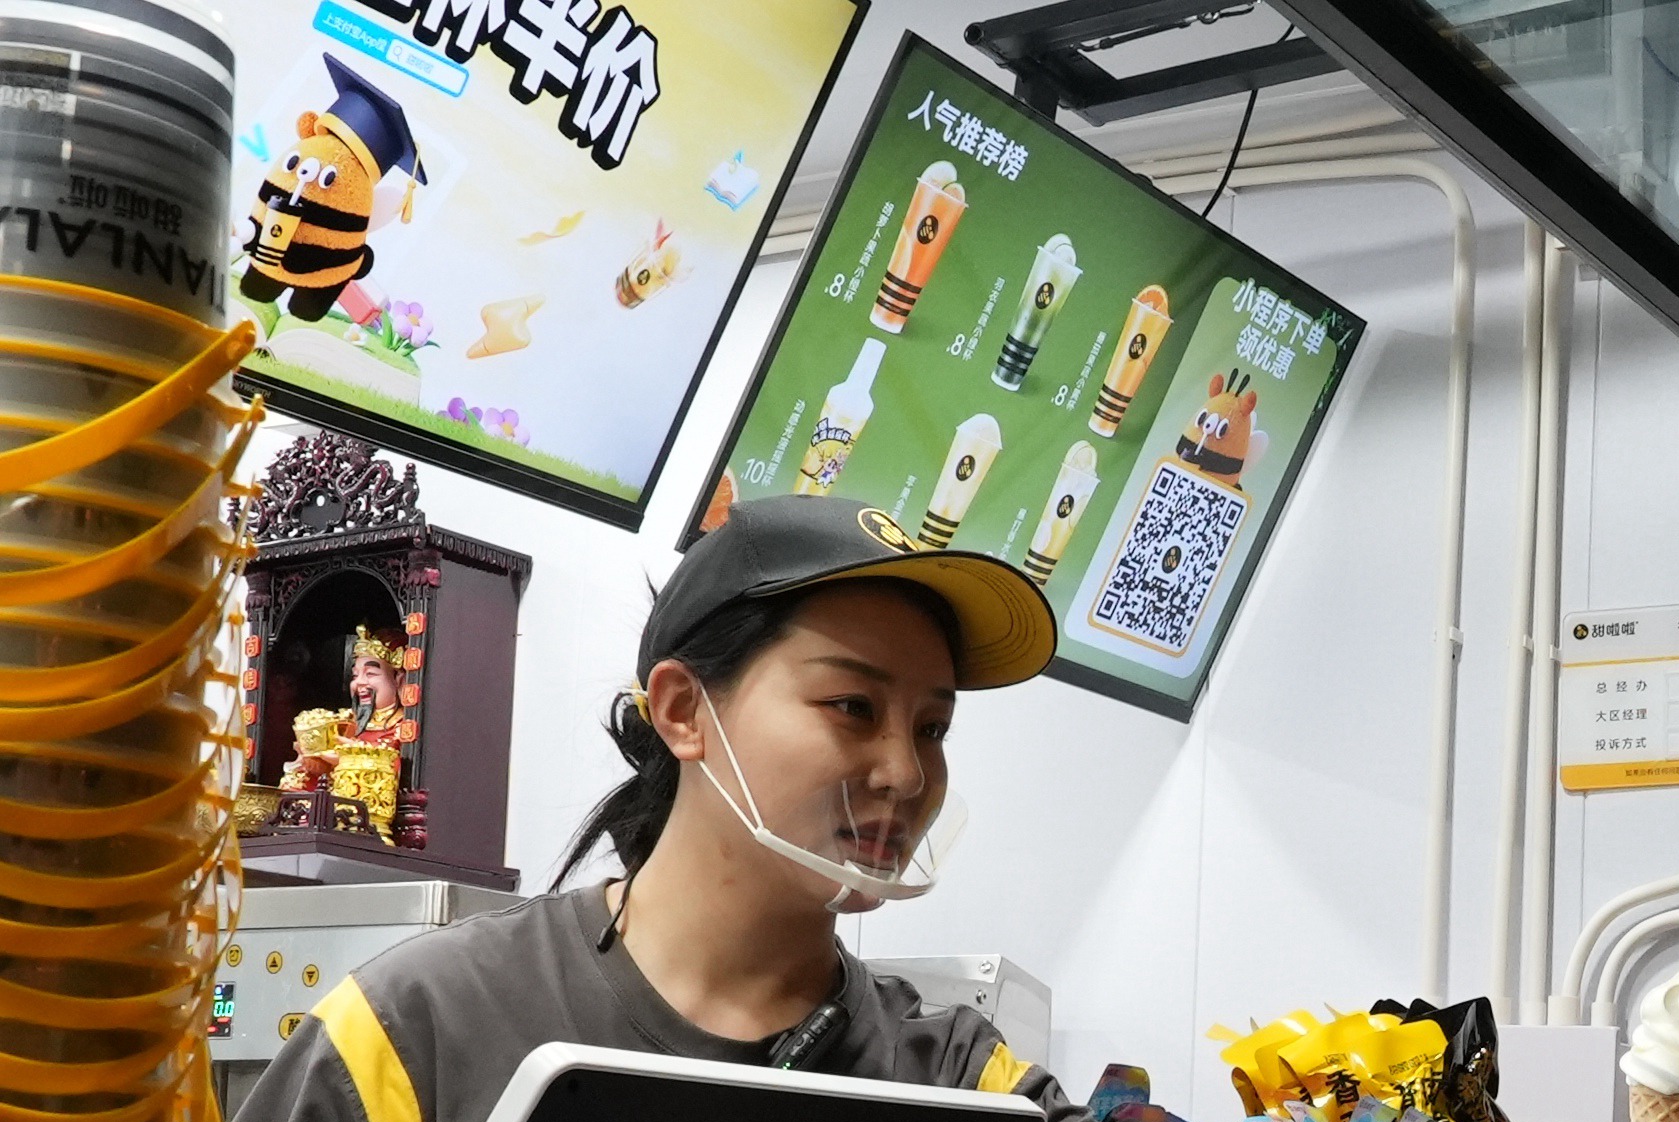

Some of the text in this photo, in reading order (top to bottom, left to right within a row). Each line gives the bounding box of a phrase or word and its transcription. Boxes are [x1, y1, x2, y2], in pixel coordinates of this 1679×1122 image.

[908, 89, 1029, 182] 人气推荐榜
[1232, 277, 1328, 355] 小程序下单
[1236, 324, 1296, 380] 领优惠
[1591, 622, 1637, 638] 甜啦啦
[1596, 680, 1648, 694] 总经办
[1595, 708, 1648, 722] 大区经理
[1595, 737, 1648, 752] 投诉方式
